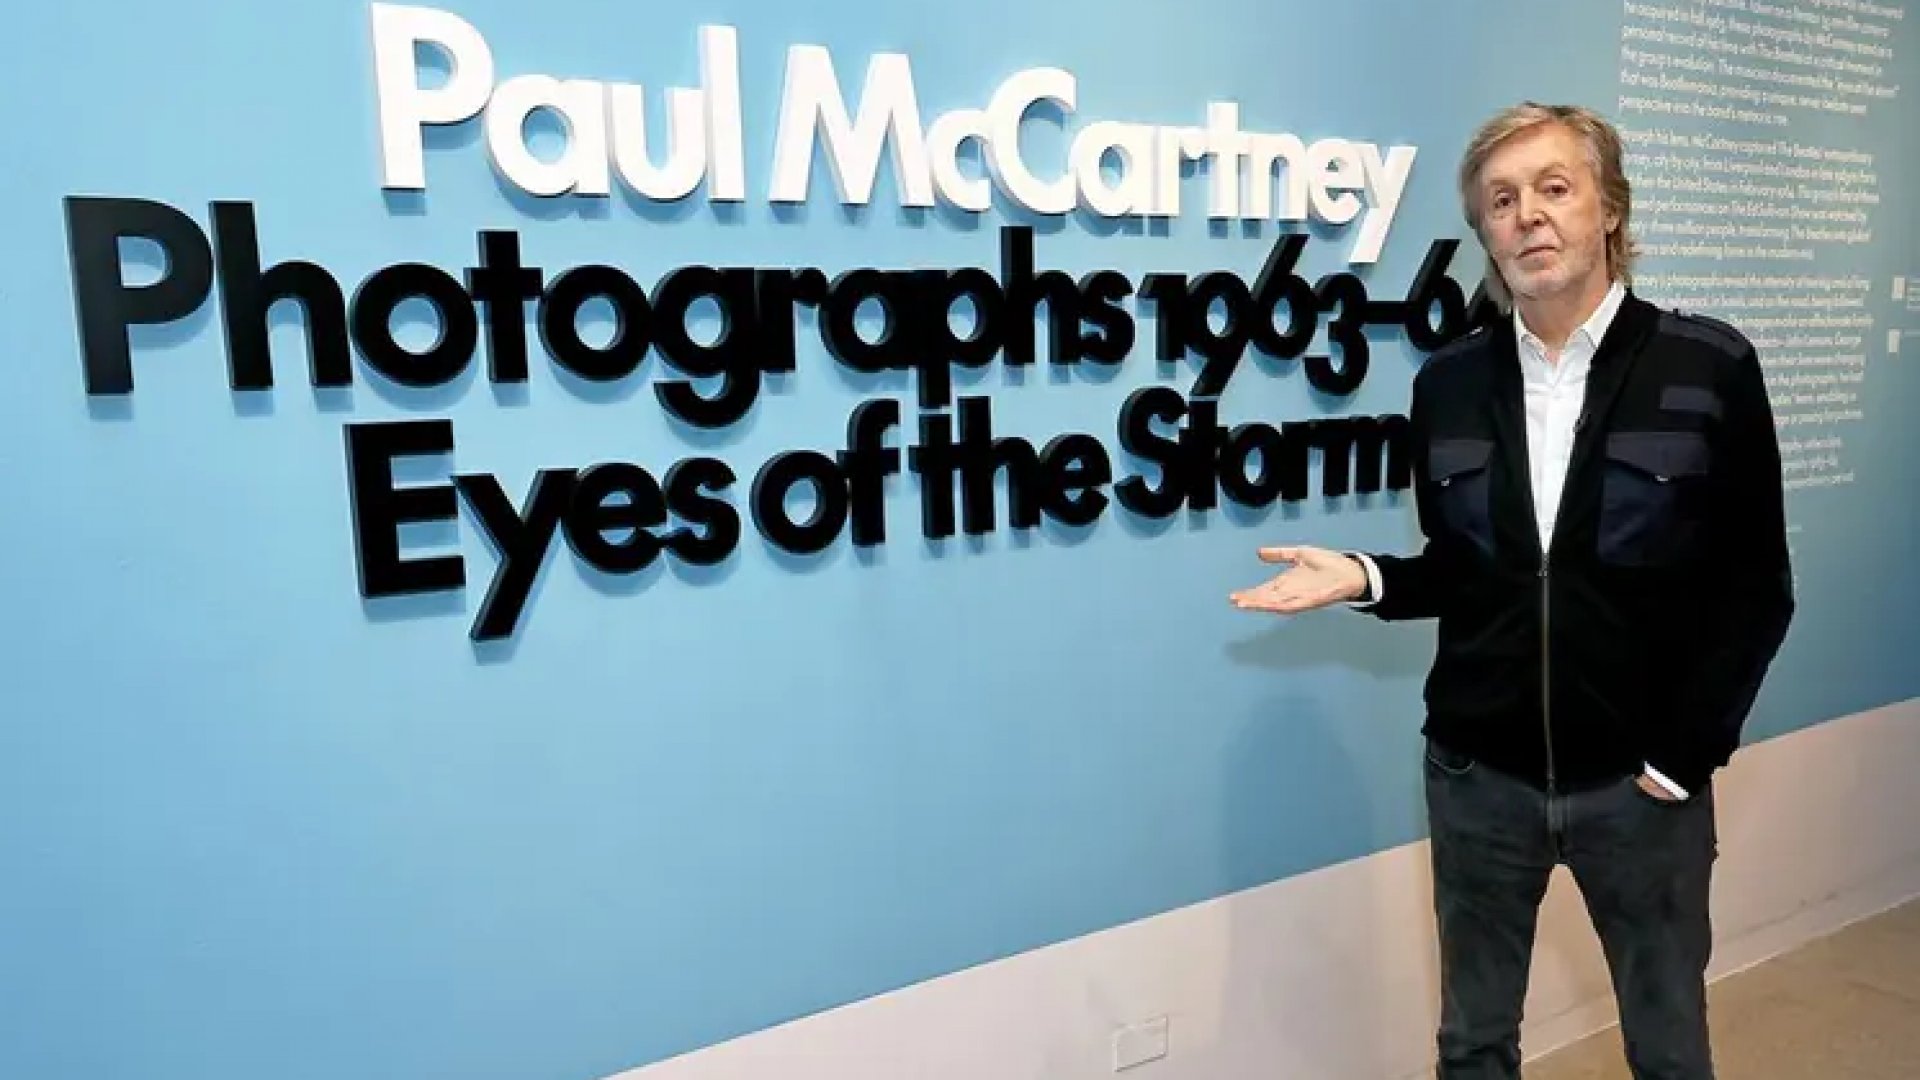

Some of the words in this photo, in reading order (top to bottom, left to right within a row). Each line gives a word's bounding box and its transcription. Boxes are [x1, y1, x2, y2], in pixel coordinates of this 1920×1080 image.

[371, 2, 746, 203] Paul
[769, 43, 1417, 263] McCartney
[63, 195, 1136, 429] Photographs
[343, 419, 741, 641] Eyes
[750, 400, 901, 555] of
[908, 396, 1113, 540] the
[1113, 386, 1413, 519] Storm
